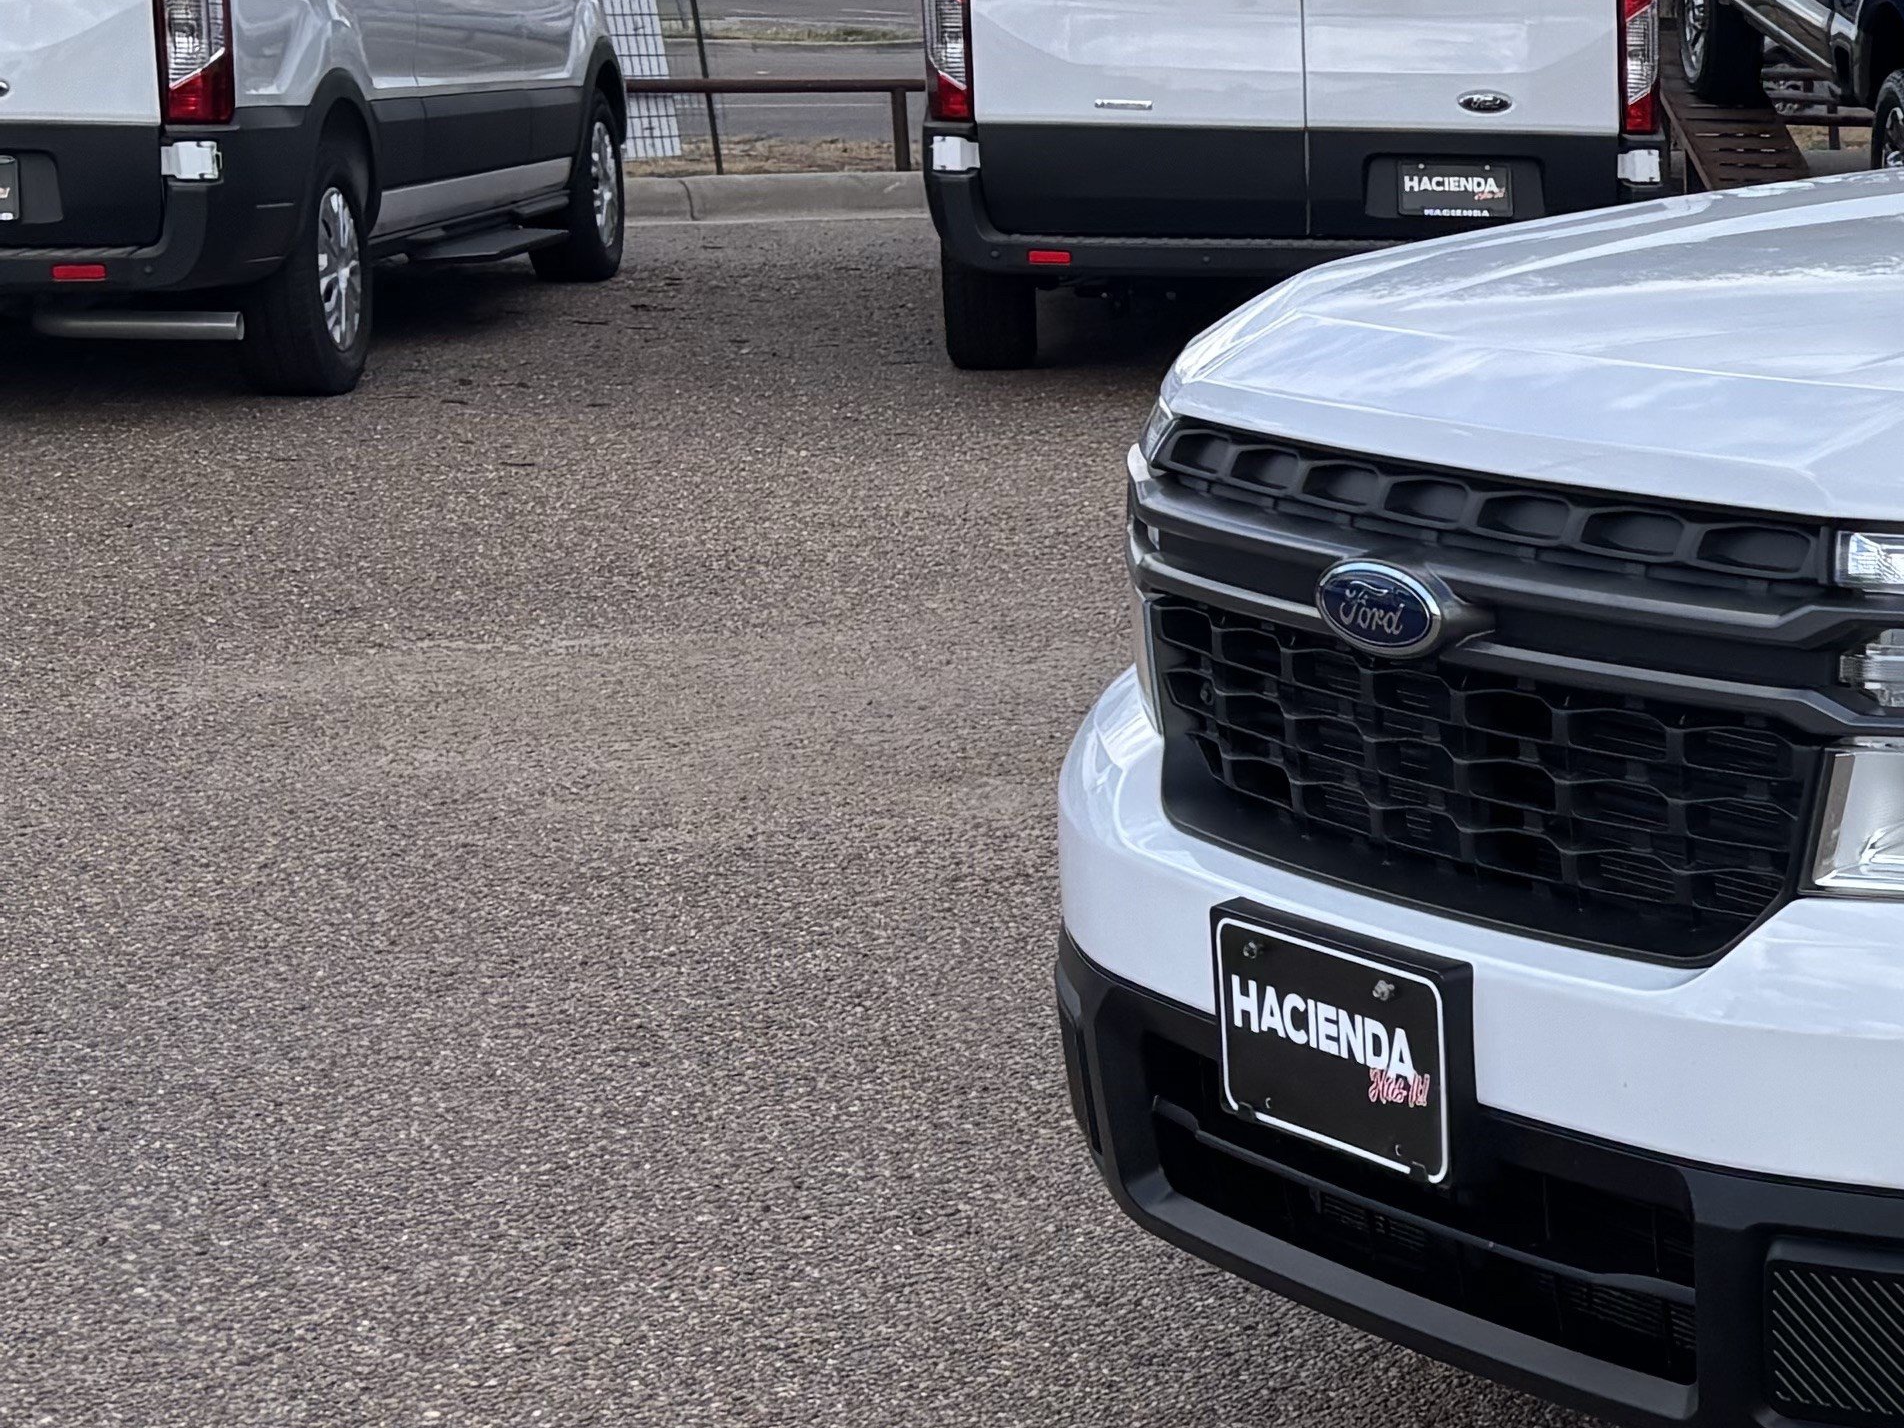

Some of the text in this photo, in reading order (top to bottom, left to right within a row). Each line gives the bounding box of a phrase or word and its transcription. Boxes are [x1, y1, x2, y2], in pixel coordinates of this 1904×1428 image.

[1403, 175, 1500, 193] HACIENDA
[1423, 208, 1490, 217] HACIENDA
[1339, 580, 1406, 636] Ford
[1230, 973, 1420, 1084] HACIENDA
